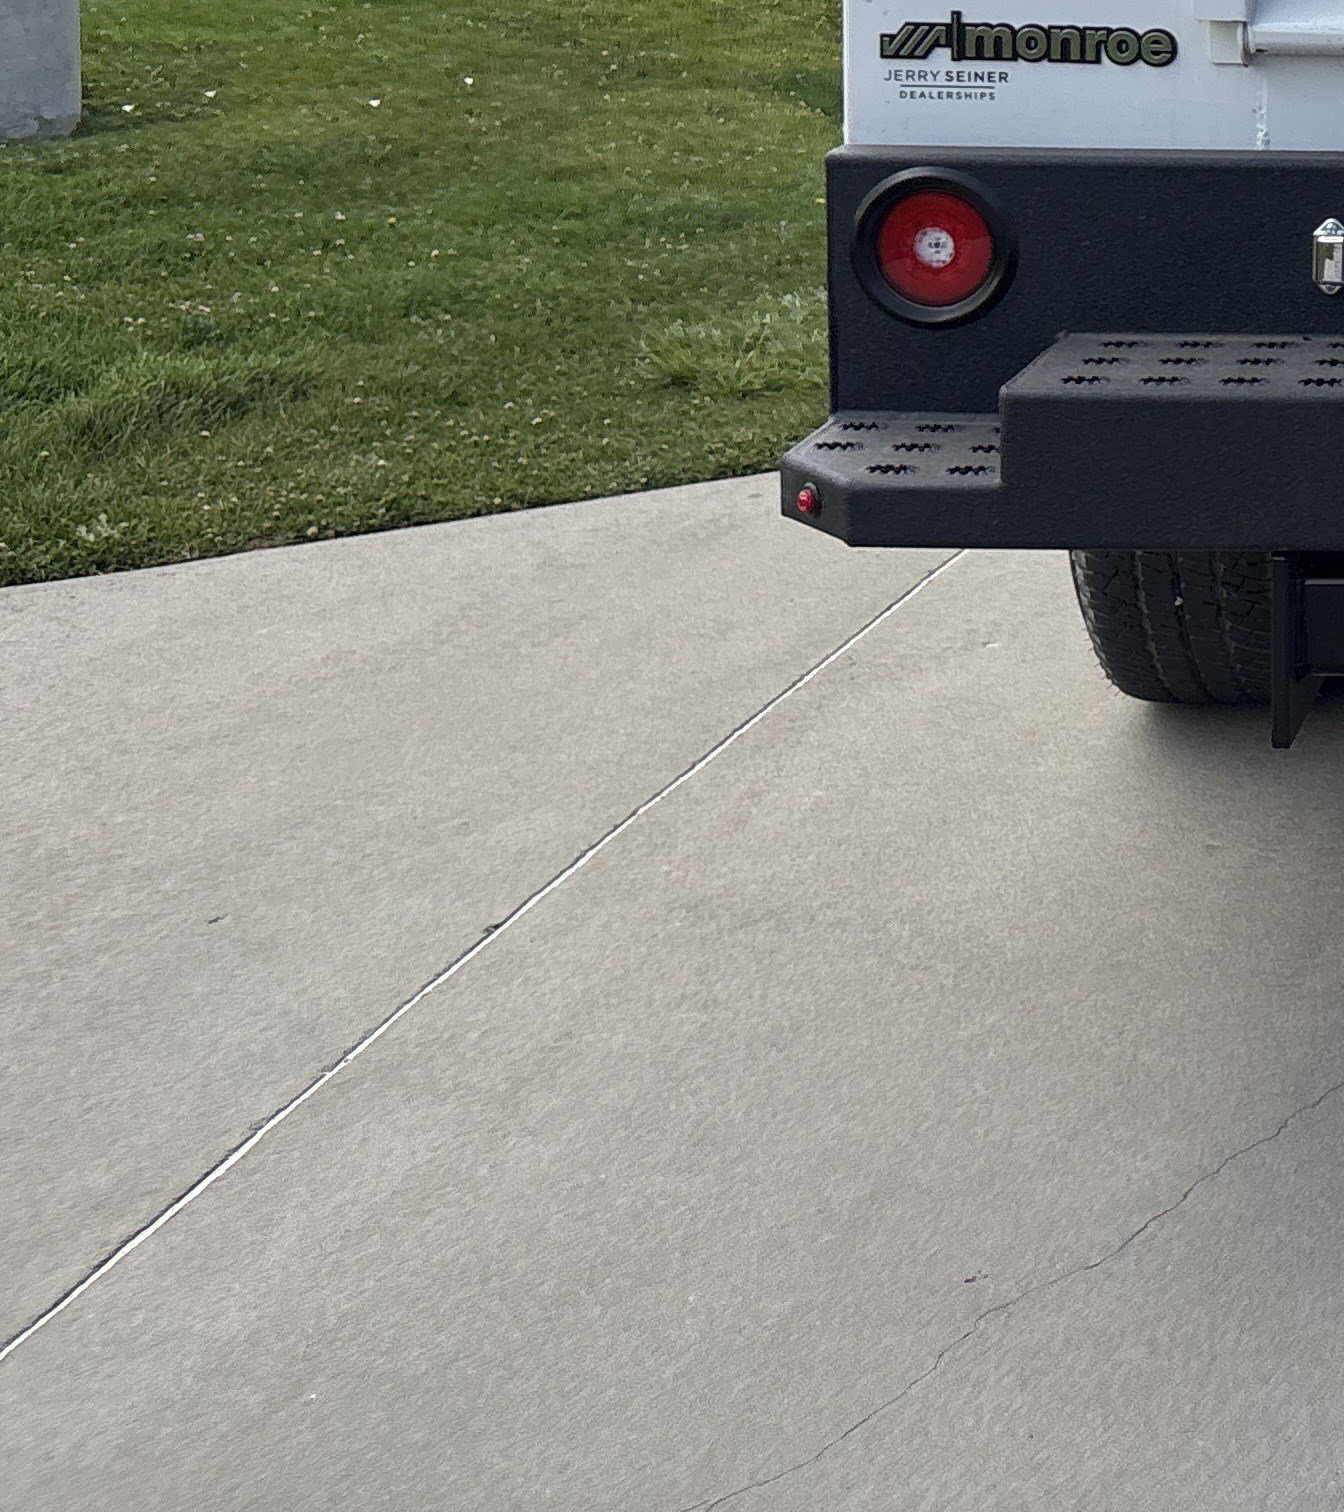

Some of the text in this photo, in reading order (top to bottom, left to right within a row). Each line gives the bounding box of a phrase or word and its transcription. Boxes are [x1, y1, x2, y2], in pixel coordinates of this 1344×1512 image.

[963, 23, 1177, 67] monroe
[884, 69, 1009, 84] JERRY SEINER
[899, 90, 996, 101] DEALERSHIPS
